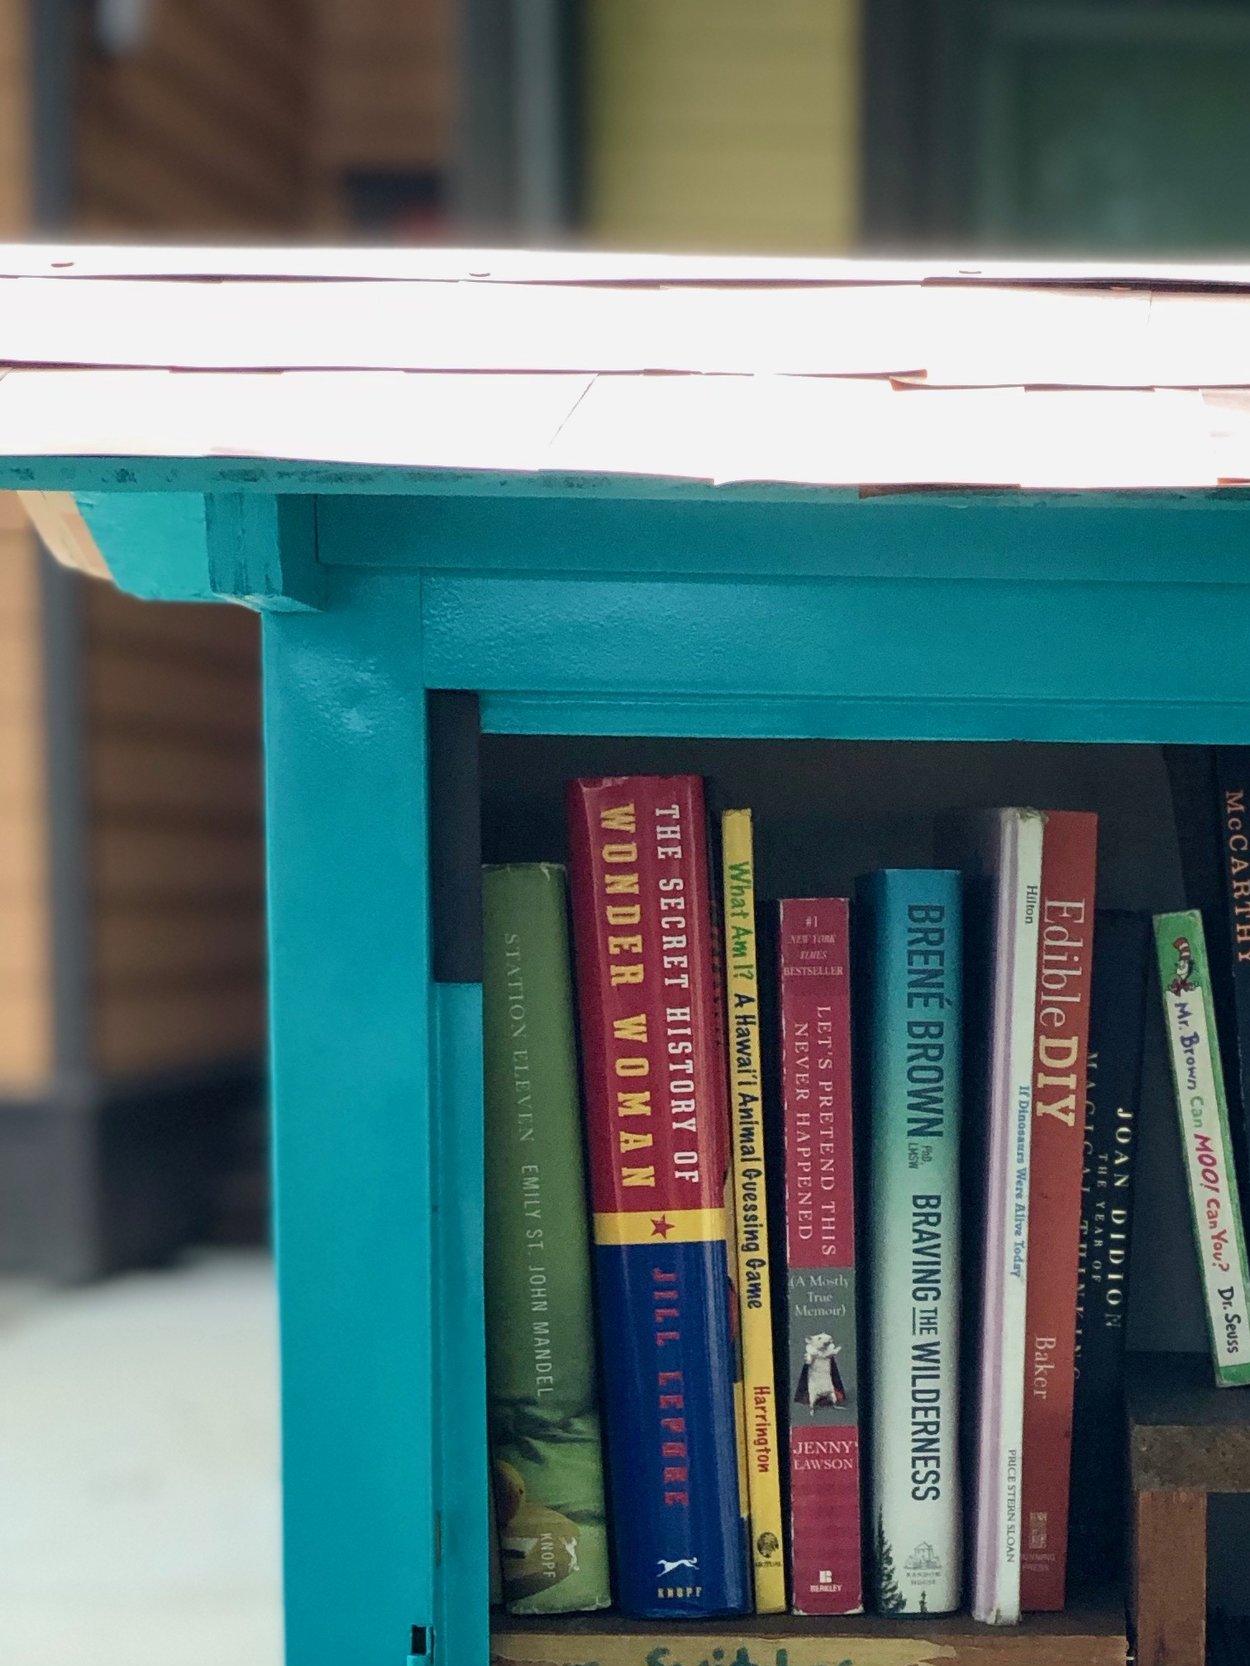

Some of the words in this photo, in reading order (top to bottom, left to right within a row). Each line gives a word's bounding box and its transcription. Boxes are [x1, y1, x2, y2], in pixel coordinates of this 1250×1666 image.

[655, 805, 682, 859] THE
[600, 803, 645, 987] WONDER
[729, 861, 754, 919] What
[1024, 885, 1039, 925] Hilton
[658, 878, 689, 988] SECRET
[731, 925, 752, 958] Am
[907, 904, 951, 1009] BRENÉ
[504, 933, 527, 1038] STATION
[732, 964, 754, 981] I?
[1040, 899, 1086, 1028] Edible
[734, 993, 756, 1008] A
[1174, 1003, 1195, 1030] Mr.
[795, 1023, 811, 1101] NEVER
[816, 1005, 834, 1069] LET'S
[1180, 1035, 1201, 1090] Brown
[511, 1049, 534, 1142] ELEVEN
[666, 1007, 697, 1132] HISTORY
[907, 1021, 944, 1137] BROWN
[1019, 1085, 1031, 1096] If
[1036, 1035, 1079, 1127] DIY
[613, 1014, 656, 1188] WOMAN
[738, 1092, 762, 1162] Animal
[1189, 1096, 1205, 1128] Can
[819, 1080, 835, 1191] PRETEND
[908, 1142, 918, 1169] LMSW
[1016, 1100, 1030, 1164] Dinosaurs
[1113, 1107, 1134, 1187] JOAN
[673, 1151, 699, 1184] OF
[796, 1112, 813, 1240] HAPPENED
[1015, 1167, 1028, 1199] Were
[1193, 1133, 1220, 1192] MOO!
[520, 1164, 542, 1218] EMILY
[741, 1168, 764, 1252] Guessing
[1206, 1198, 1223, 1229] Can
[525, 1228, 544, 1256] ST.
[822, 1201, 836, 1256] THIS
[911, 1194, 941, 1301] BRAVING
[1013, 1203, 1026, 1237] Alive
[1010, 1241, 1025, 1277] Today
[1105, 1210, 1129, 1329] DIDION
[1211, 1229, 1231, 1272] You?
[528, 1265, 547, 1312] JOHN
[652, 1268, 680, 1346] JILL
[744, 1258, 766, 1310] Game
[807, 1291, 833, 1302] True
[1217, 1287, 1235, 1310] Dr.
[920, 1307, 938, 1335] THE
[1223, 1313, 1242, 1353] Seuss
[532, 1321, 555, 1397] MANDEL
[1033, 1336, 1056, 1400] Baker
[657, 1371, 689, 1509] LEPORE
[752, 1386, 771, 1473] Harrington
[793, 1442, 853, 1455] JENNY
[911, 1341, 941, 1501] WILDERNESS
[793, 1459, 853, 1470] LAWSON
[1007, 1449, 1017, 1482] PRICE
[1006, 1484, 1017, 1521] STERN
[539, 1532, 557, 1579] KNOPF
[1006, 1524, 1016, 1563] SLOAN
